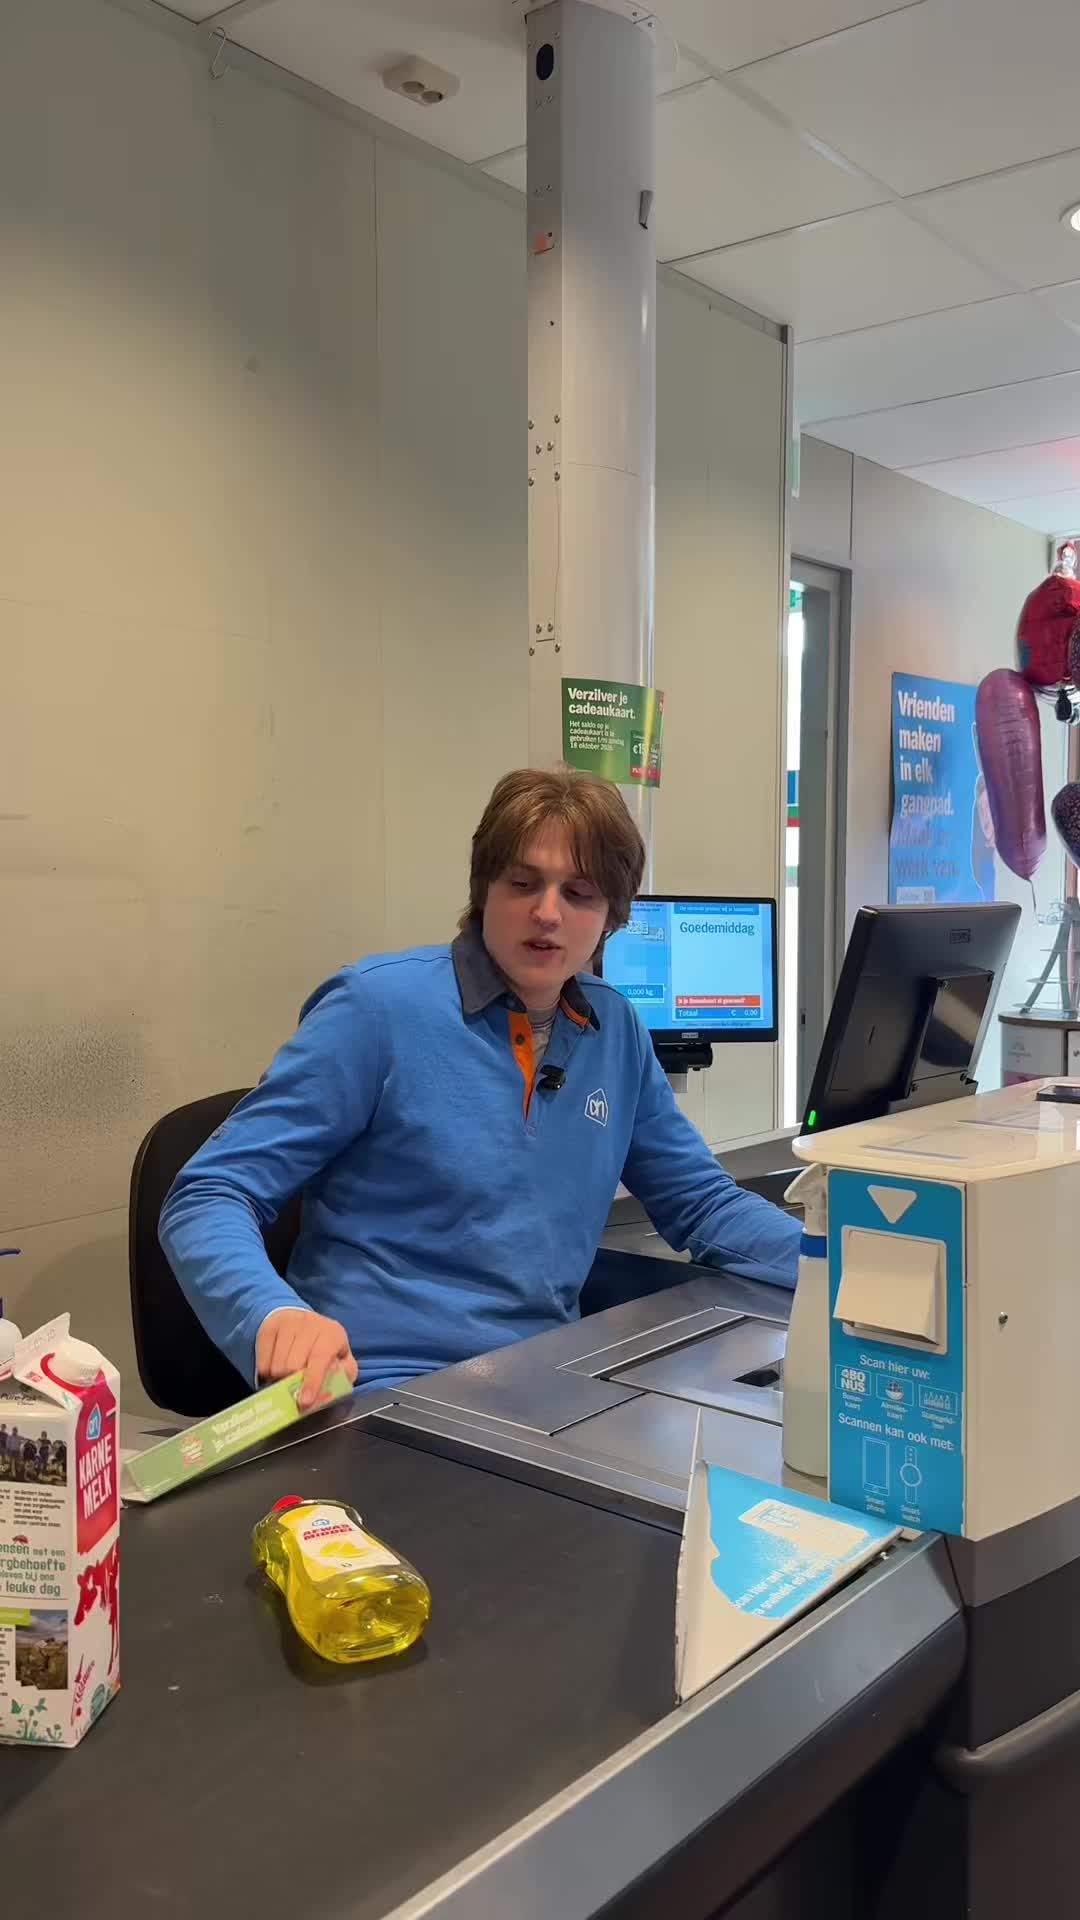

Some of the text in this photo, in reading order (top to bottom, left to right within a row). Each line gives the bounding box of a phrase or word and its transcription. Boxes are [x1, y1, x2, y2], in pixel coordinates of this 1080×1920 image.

[567, 687, 628, 706] Verzilver je
[898, 690, 955, 723] Vrienden
[568, 702, 636, 719] cadeaukaart.
[899, 725, 942, 752] maken
[900, 755, 934, 785] in elk
[901, 791, 955, 818] gangpad.
[680, 922, 755, 936] Goedemiddag
[679, 1009, 698, 1017] Totaal
[859, 1354, 930, 1380] Scan hier uw:
[841, 1378, 865, 1392] NUS
[838, 1413, 954, 1450] Scannen kan ook met:
[79, 1433, 112, 1489] KARNE
[83, 1466, 112, 1520] MELK
[304, 1527, 352, 1541] MIDDEL
[6, 1580, 61, 1597] leuke dag
